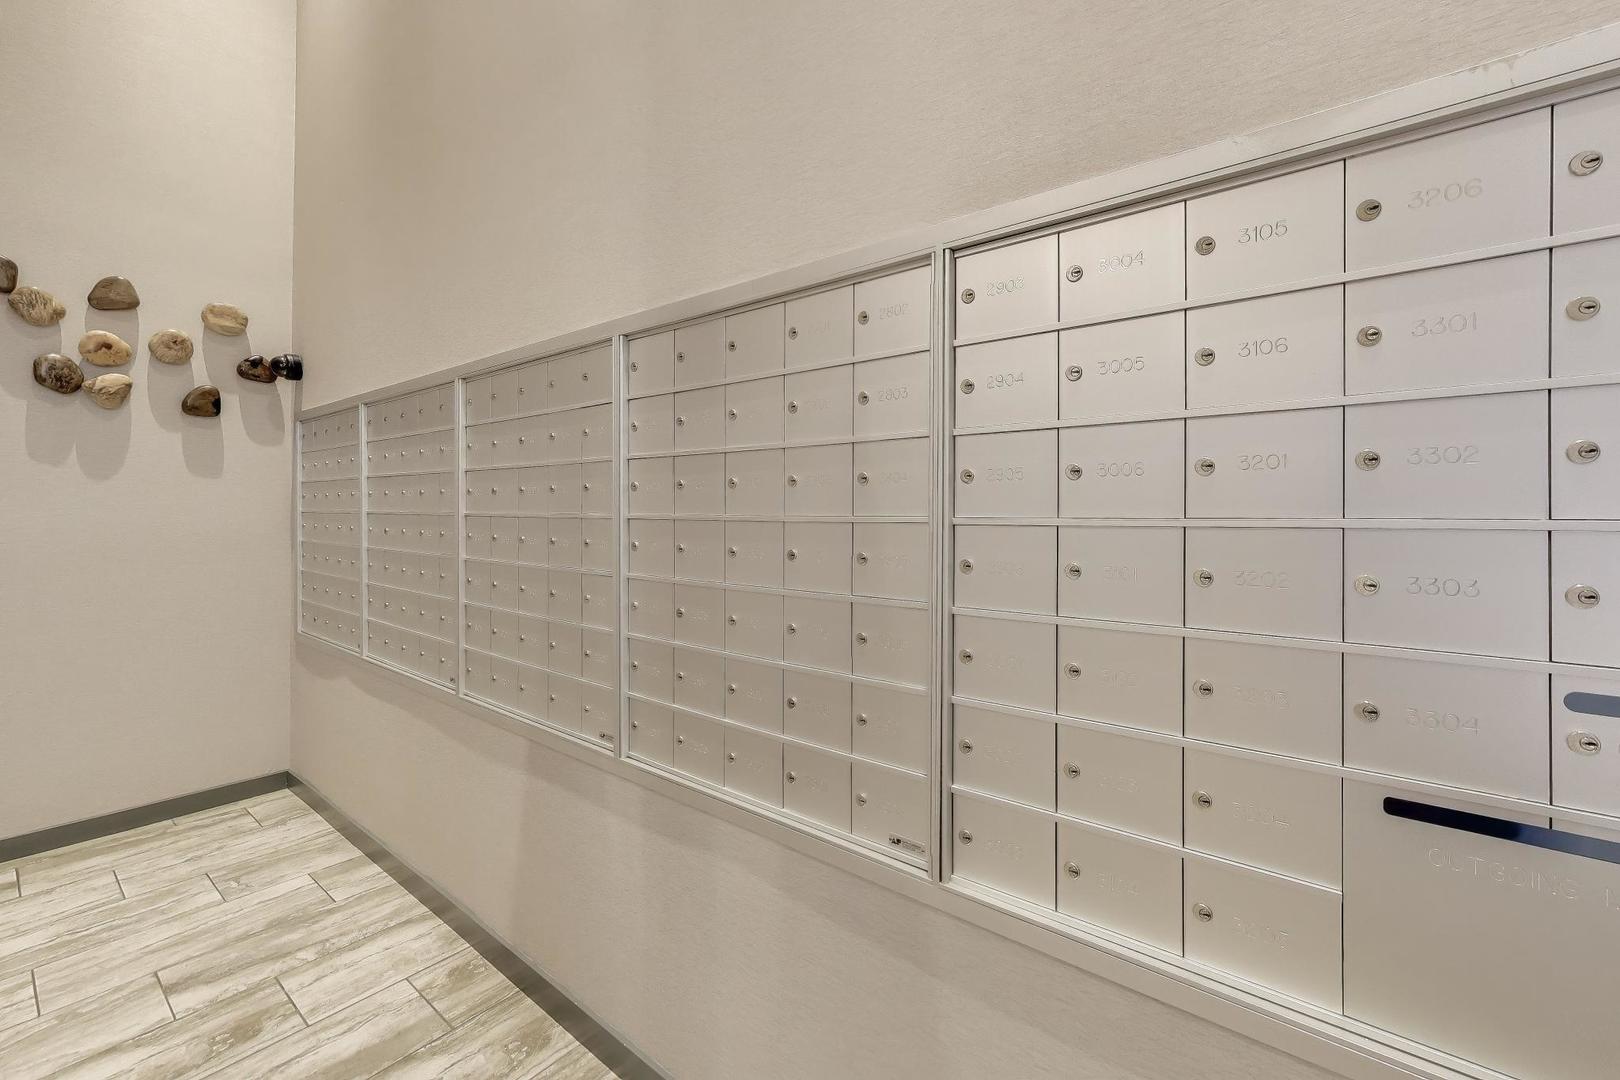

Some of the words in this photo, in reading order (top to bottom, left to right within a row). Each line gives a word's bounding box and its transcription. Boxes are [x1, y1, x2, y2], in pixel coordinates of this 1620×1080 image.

[1407, 177, 1482, 209] 3206
[1237, 218, 1288, 244] 3105
[1098, 250, 1146, 274] 3004
[1410, 312, 1478, 338] 3301
[1237, 337, 1289, 358] 3106
[1097, 355, 1146, 375] 3005
[986, 371, 1025, 389] 2904
[878, 386, 909, 402] 2803
[1236, 452, 1288, 471] 3201
[1406, 445, 1480, 466] 3302
[1096, 461, 1146, 478] 3006
[1233, 570, 1290, 589] 3202
[1405, 575, 1481, 598] 3303
[1405, 706, 1480, 735] 3304
[1427, 847, 1578, 900] OUTGOING
